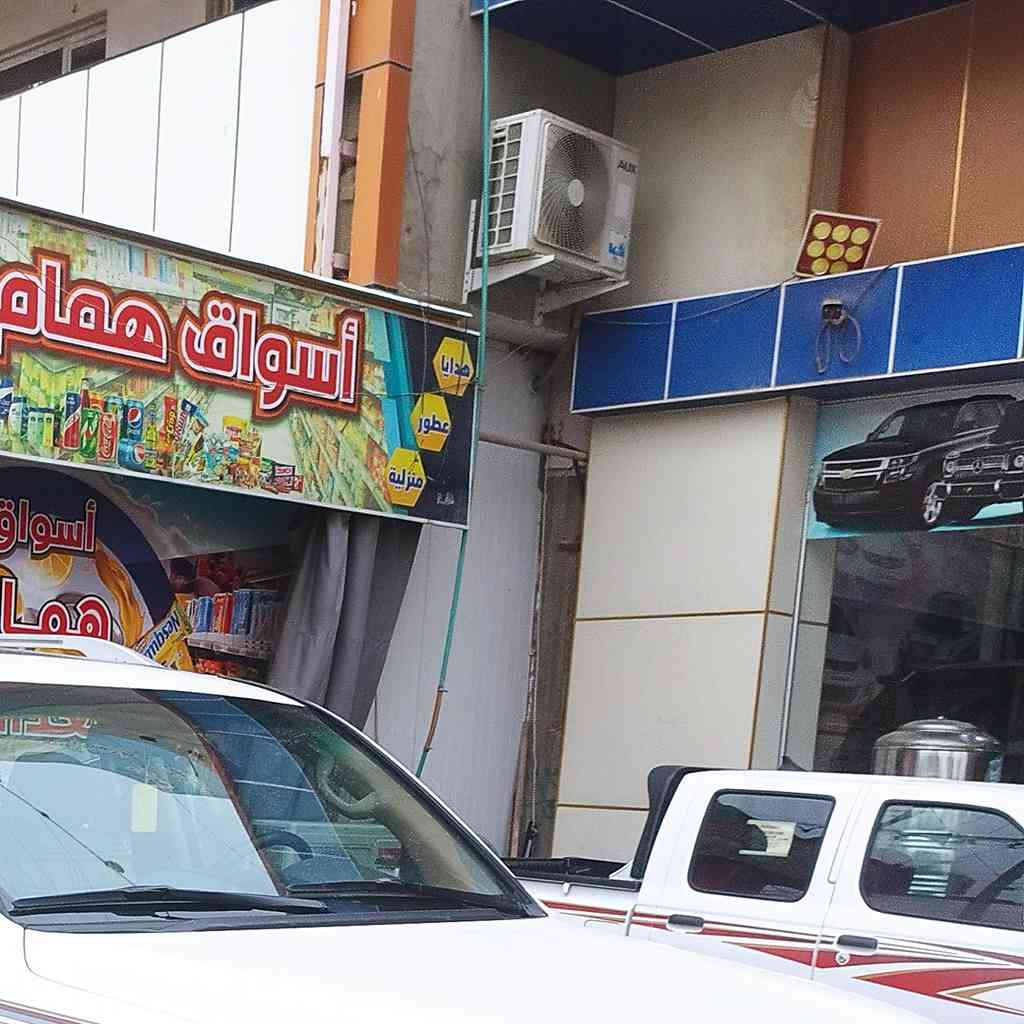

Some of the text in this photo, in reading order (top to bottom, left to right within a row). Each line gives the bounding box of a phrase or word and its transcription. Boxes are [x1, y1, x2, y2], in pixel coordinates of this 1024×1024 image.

[180, 299, 360, 410] أسواق
[440, 355, 471, 377] هدايا
[417, 414, 449, 434] عطور
[388, 467, 424, 490] منزلية
[142, 608, 181, 660] Nesqui
